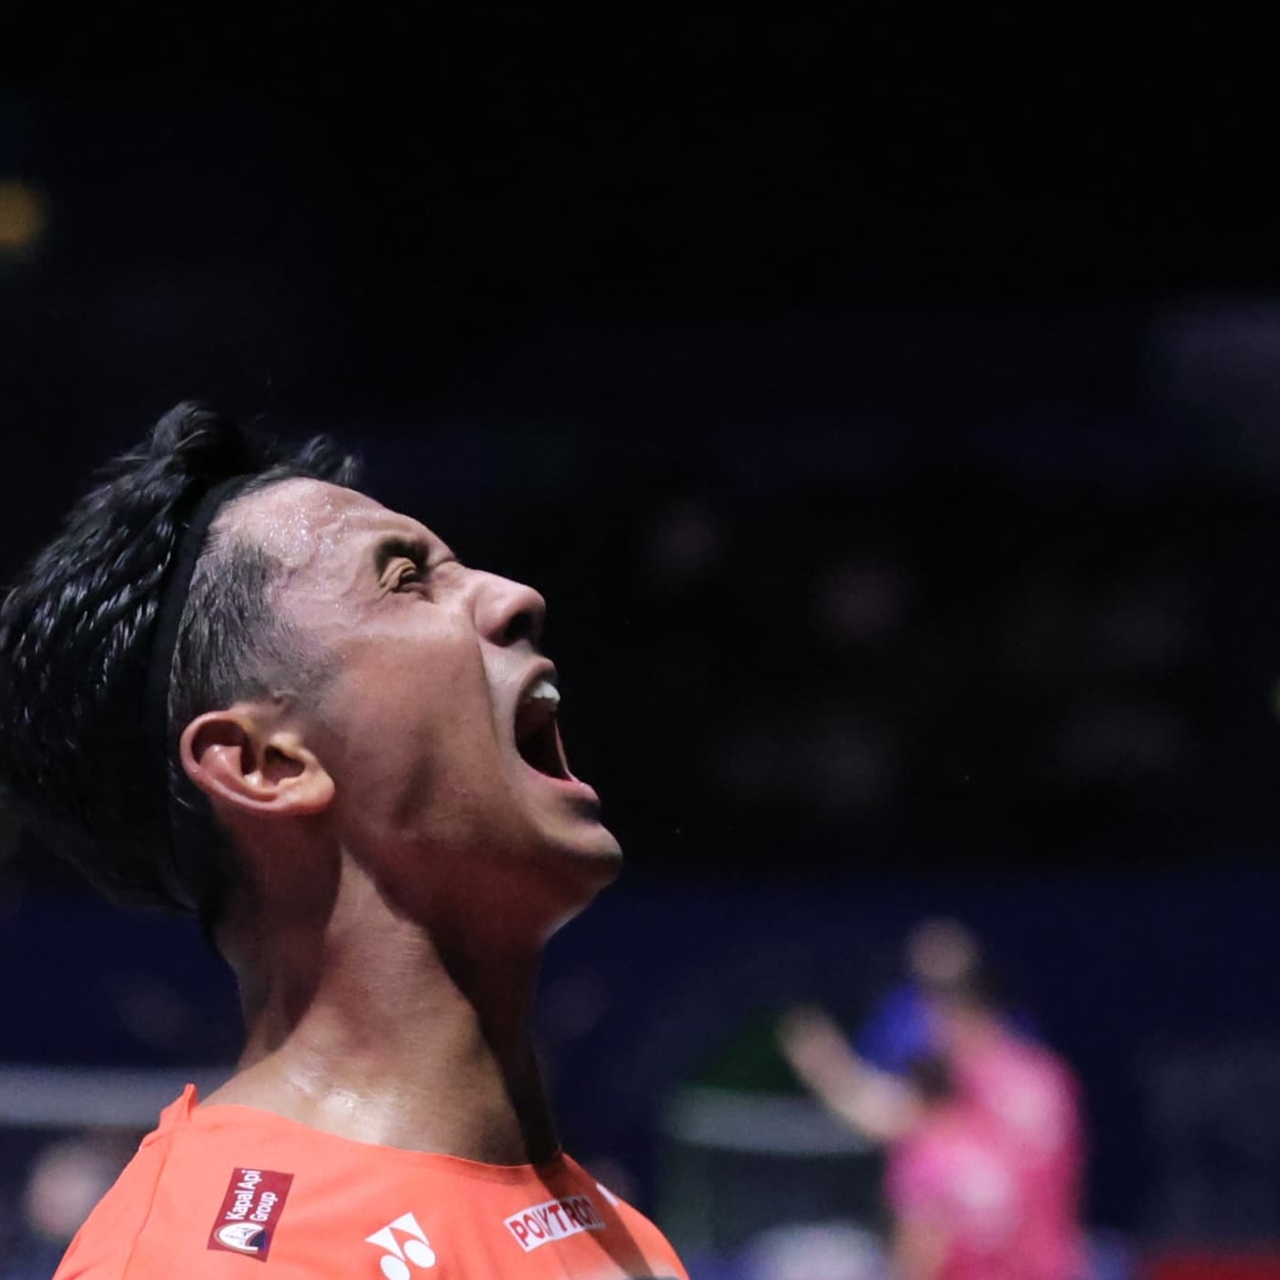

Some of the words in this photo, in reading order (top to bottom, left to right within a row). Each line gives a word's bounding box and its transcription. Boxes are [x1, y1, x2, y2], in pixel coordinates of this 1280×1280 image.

[237, 1169, 262, 1190] Api
[225, 1190, 255, 1220] Kapal
[249, 1191, 278, 1222] Group
